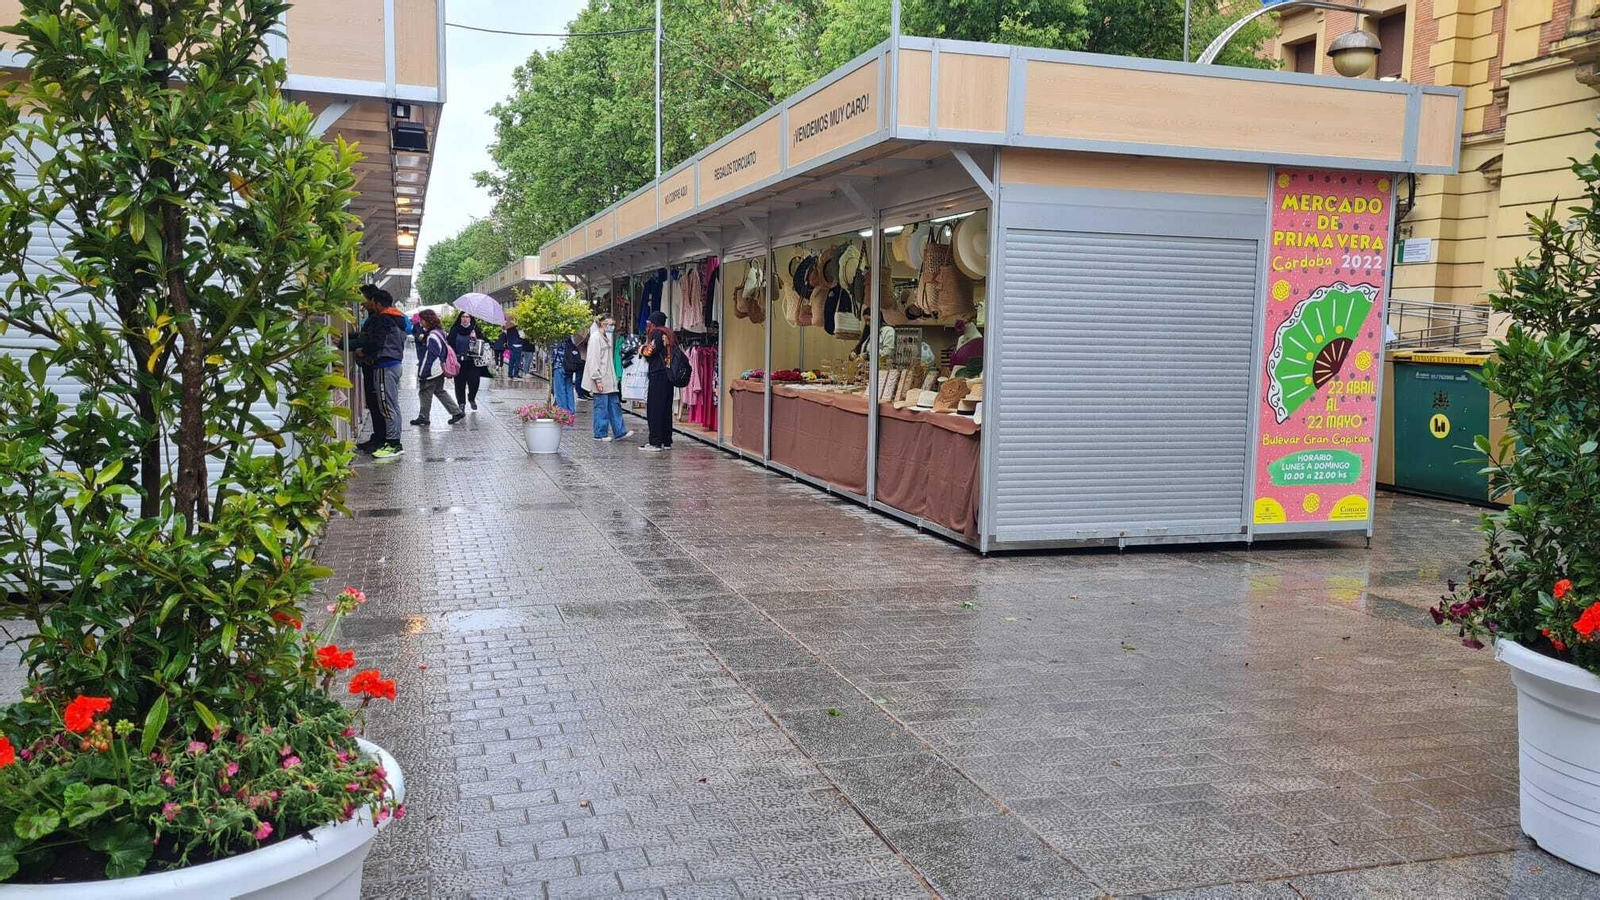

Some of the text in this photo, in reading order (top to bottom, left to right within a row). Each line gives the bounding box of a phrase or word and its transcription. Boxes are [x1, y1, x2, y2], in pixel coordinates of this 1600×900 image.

[830, 105, 845, 127] MUY
[846, 93, 869, 120] CARO!
[732, 151, 757, 173] TORCUATO
[1282, 194, 1382, 214] MERCADO
[1317, 215, 1341, 230] DE
[1273, 231, 1384, 250] PRIMAVERA
[1341, 254, 1383, 269] 2022
[1327, 381, 1375, 394] 22 ABRIL
[1326, 398, 1339, 412] AL
[1307, 414, 1363, 429] 22 MAYO
[1262, 433, 1300, 446] Bulevar
[1304, 433, 1329, 445] Gran
[1298, 454, 1334, 462] HORARIO:
[1281, 463, 1305, 471] LUNES
[1314, 462, 1350, 470] DOMINGO
[1313, 472, 1336, 480] 22.00
